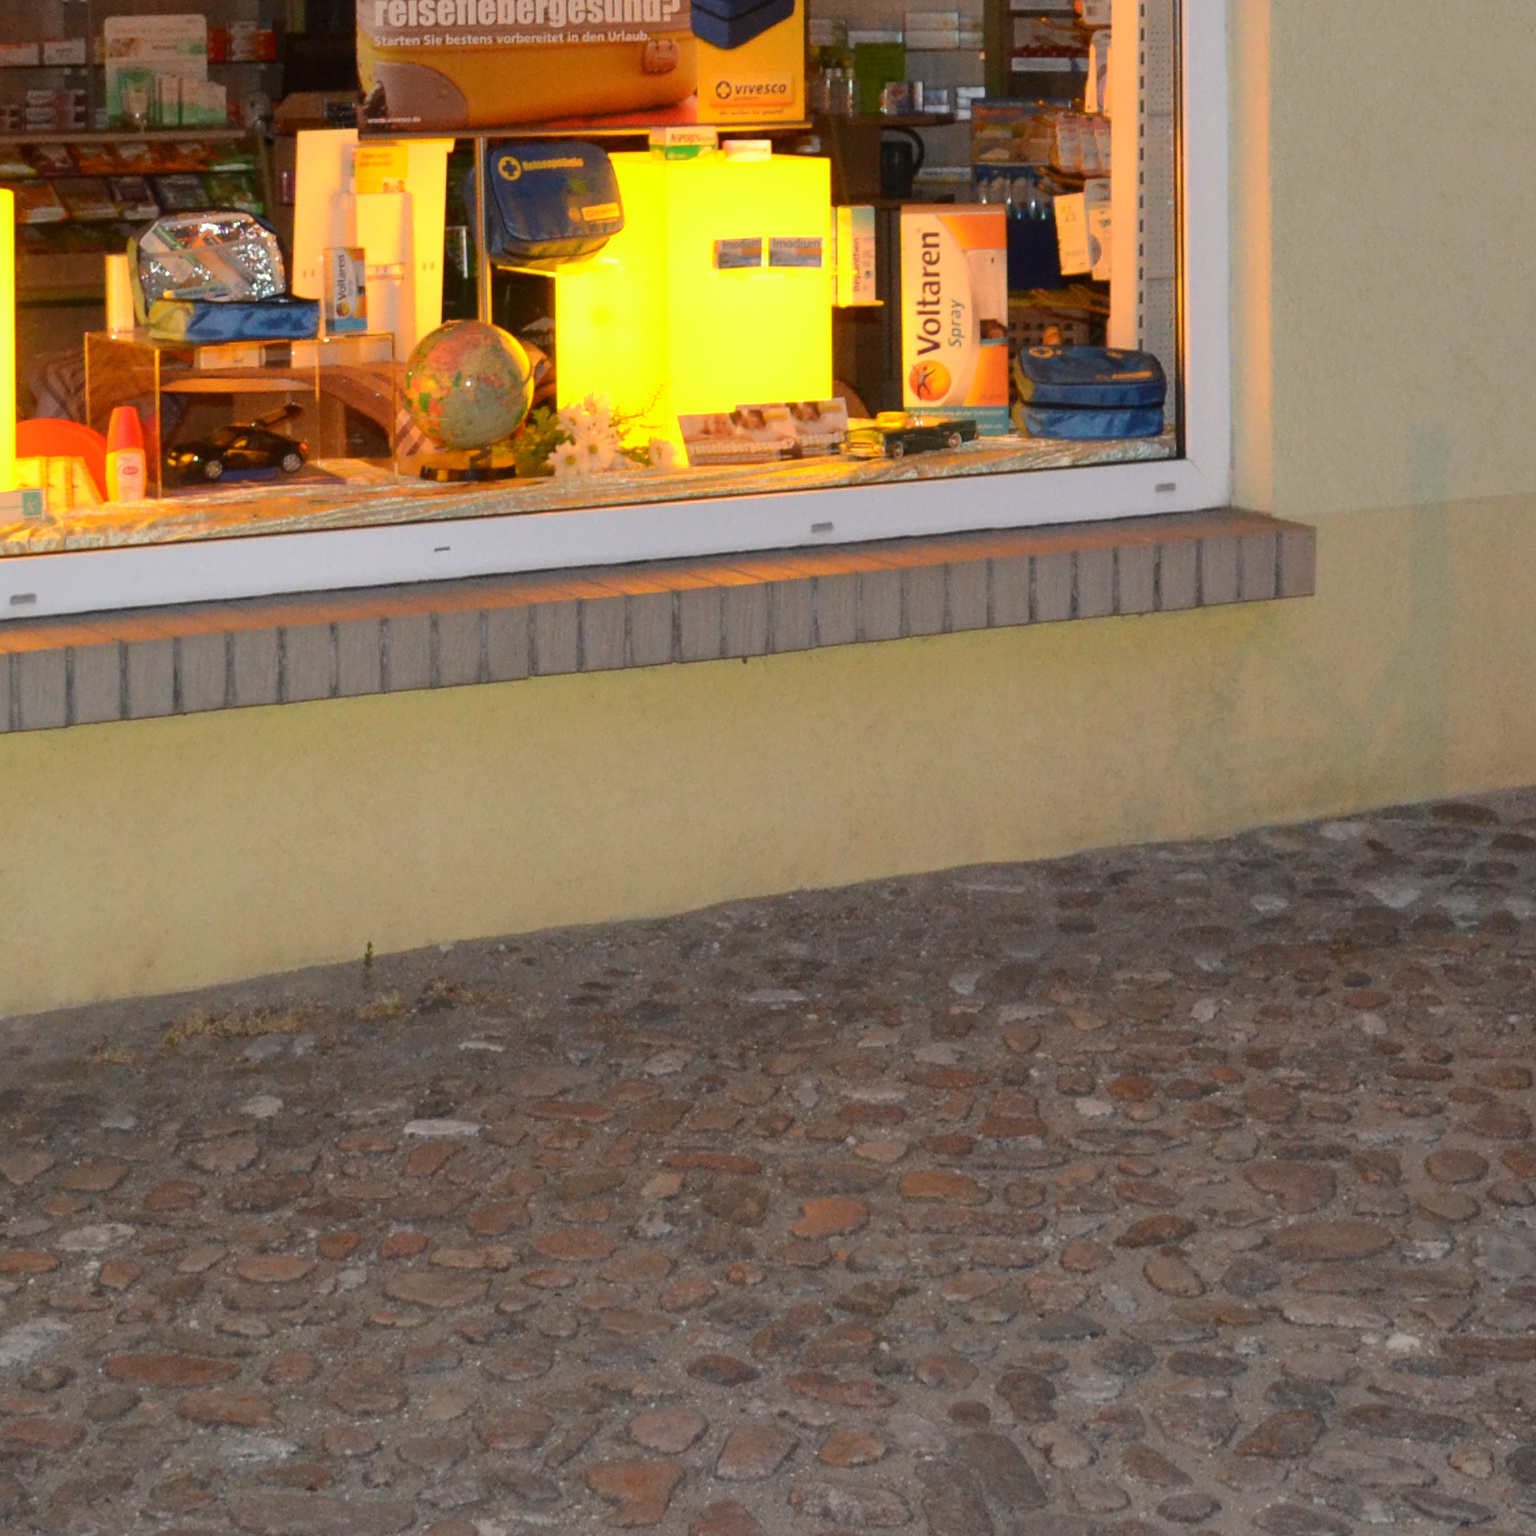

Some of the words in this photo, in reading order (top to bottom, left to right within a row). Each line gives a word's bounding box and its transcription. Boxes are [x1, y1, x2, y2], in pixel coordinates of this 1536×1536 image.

[374, 34, 421, 46] Starten
[424, 34, 443, 46] Sie
[446, 33, 493, 45] bestens
[496, 32, 564, 45] vorbereitet
[567, 32, 579, 43] in
[582, 31, 605, 43] den
[608, 31, 651, 42] Urlaub.
[735, 83, 787, 96] vivesco
[722, 238, 761, 250] Imodium
[772, 238, 821, 249] Imodium
[338, 254, 347, 301] Voltaren
[916, 231, 941, 356] Voltaren
[948, 299, 965, 348] Spray
